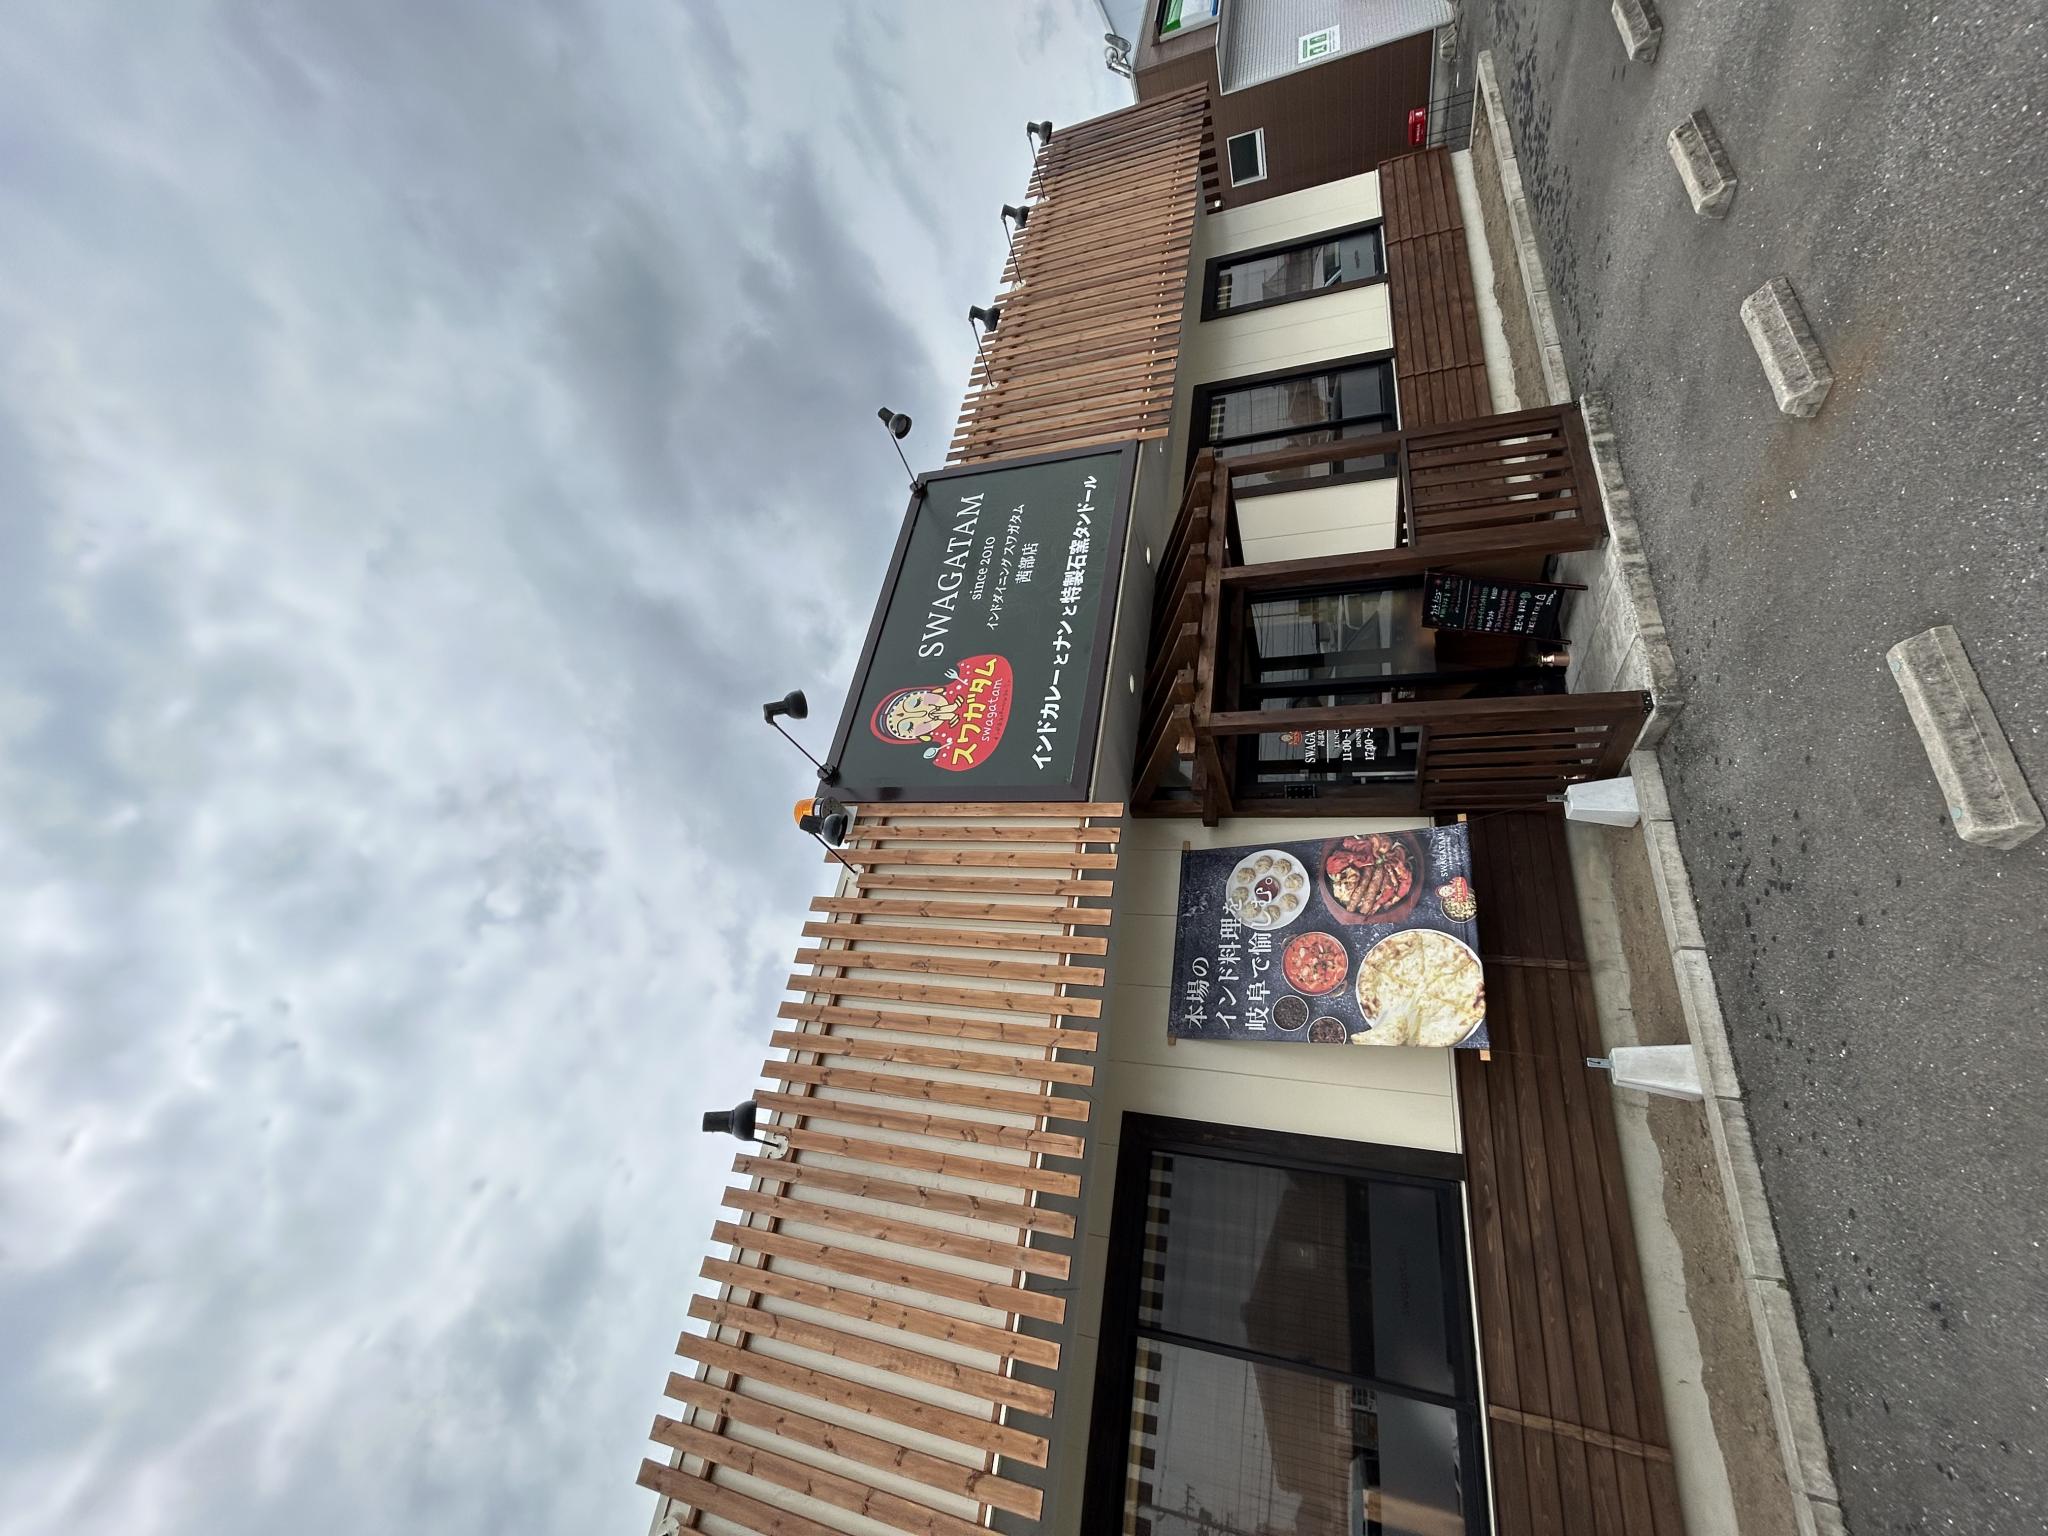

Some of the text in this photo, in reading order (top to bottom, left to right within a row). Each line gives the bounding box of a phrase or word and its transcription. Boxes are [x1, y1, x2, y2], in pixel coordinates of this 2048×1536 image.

[918, 492, 984, 658] SWAGATAM
[969, 536, 996, 600] since 2010
[986, 504, 1025, 631] インドダイニング スワガタム
[1015, 542, 1039, 584] 茜部店
[951, 657, 998, 765] スワガタム
[980, 678, 1004, 742] swagatam
[1305, 731, 1316, 763] SWAGA
[1438, 832, 1449, 877] SWAGATAM
[1216, 897, 1242, 1030] インド料理を
[1244, 876, 1273, 1031] 岐阜で愉しむ。
[1184, 956, 1210, 1029] 本場の
